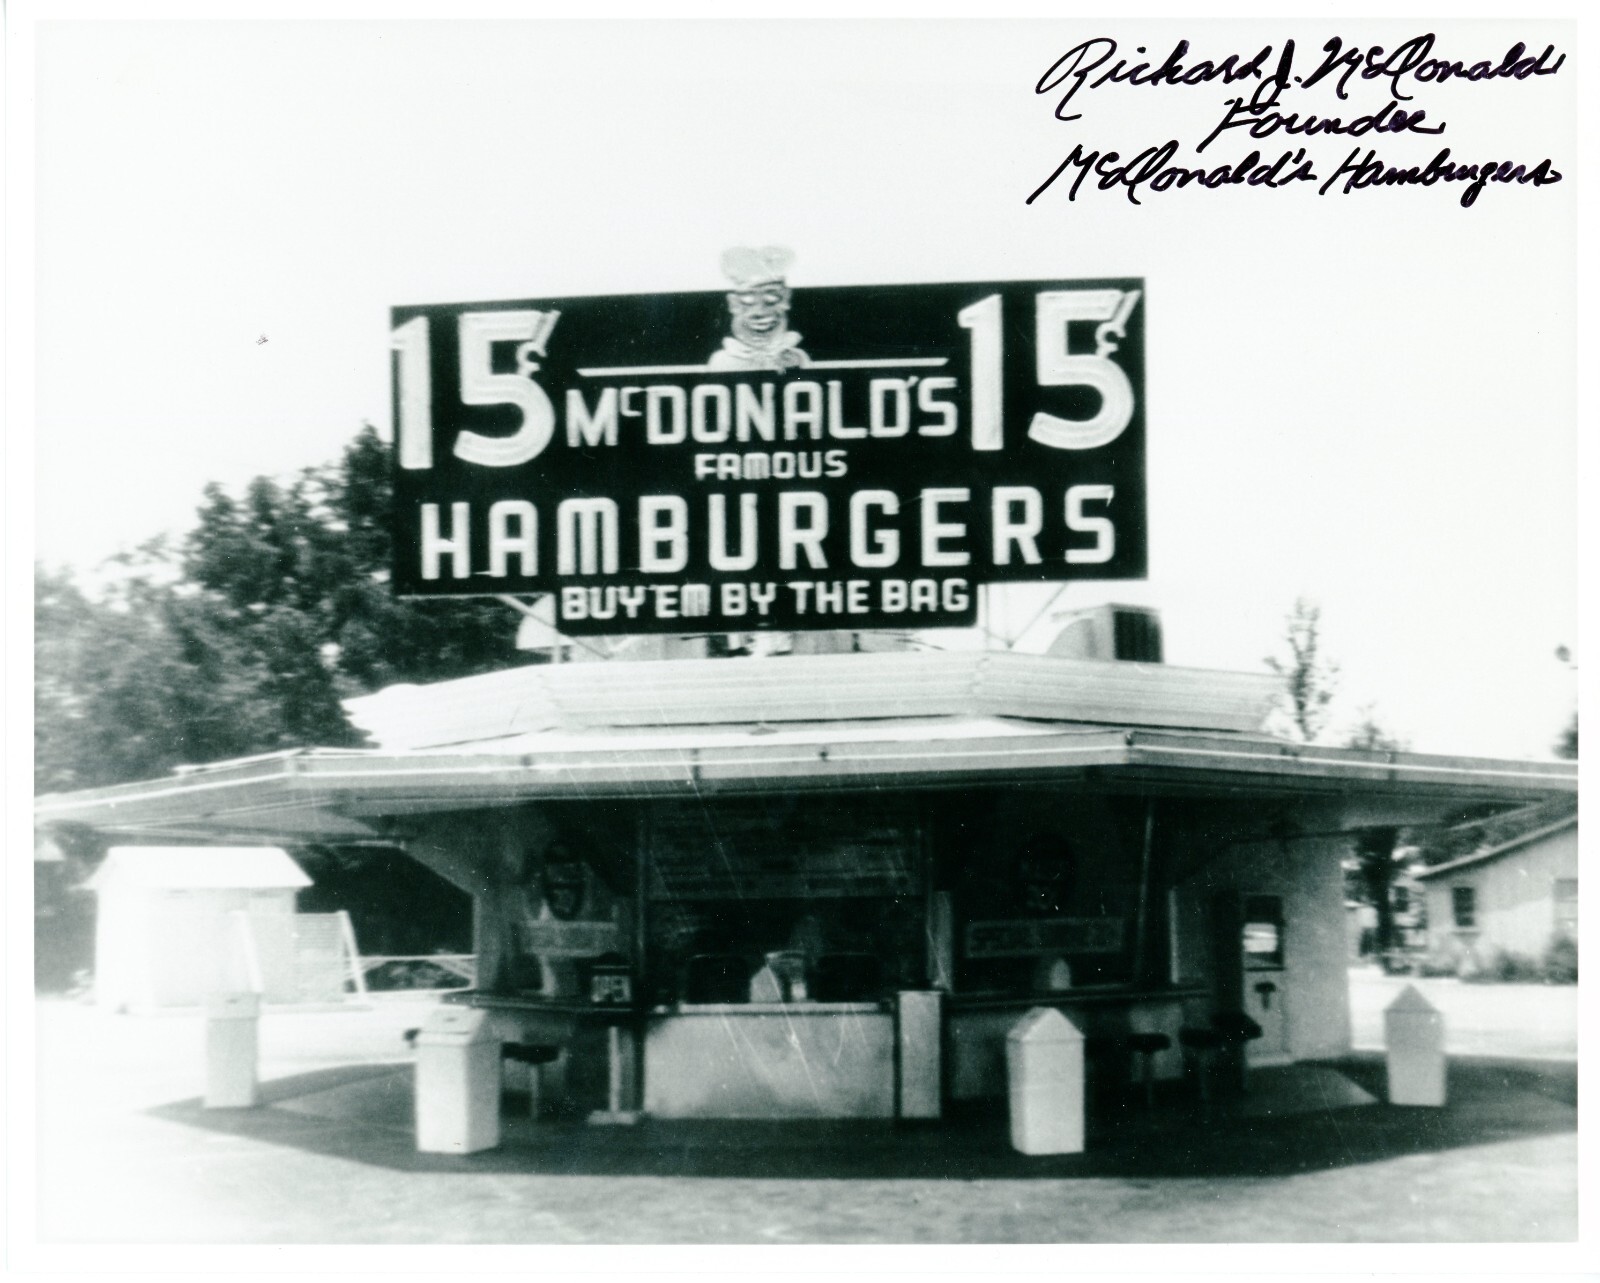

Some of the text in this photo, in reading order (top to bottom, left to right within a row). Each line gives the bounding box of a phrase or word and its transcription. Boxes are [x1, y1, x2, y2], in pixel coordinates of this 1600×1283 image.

[1035, 37, 1273, 121] Richard
[1318, 146, 1563, 209] Hamburgers
[694, 450, 848, 481] FAMOUS
[420, 484, 1116, 581] HAMBURGERS
[720, 582, 777, 617] BY
[787, 580, 870, 615] THE
[880, 577, 970, 613] BAG
